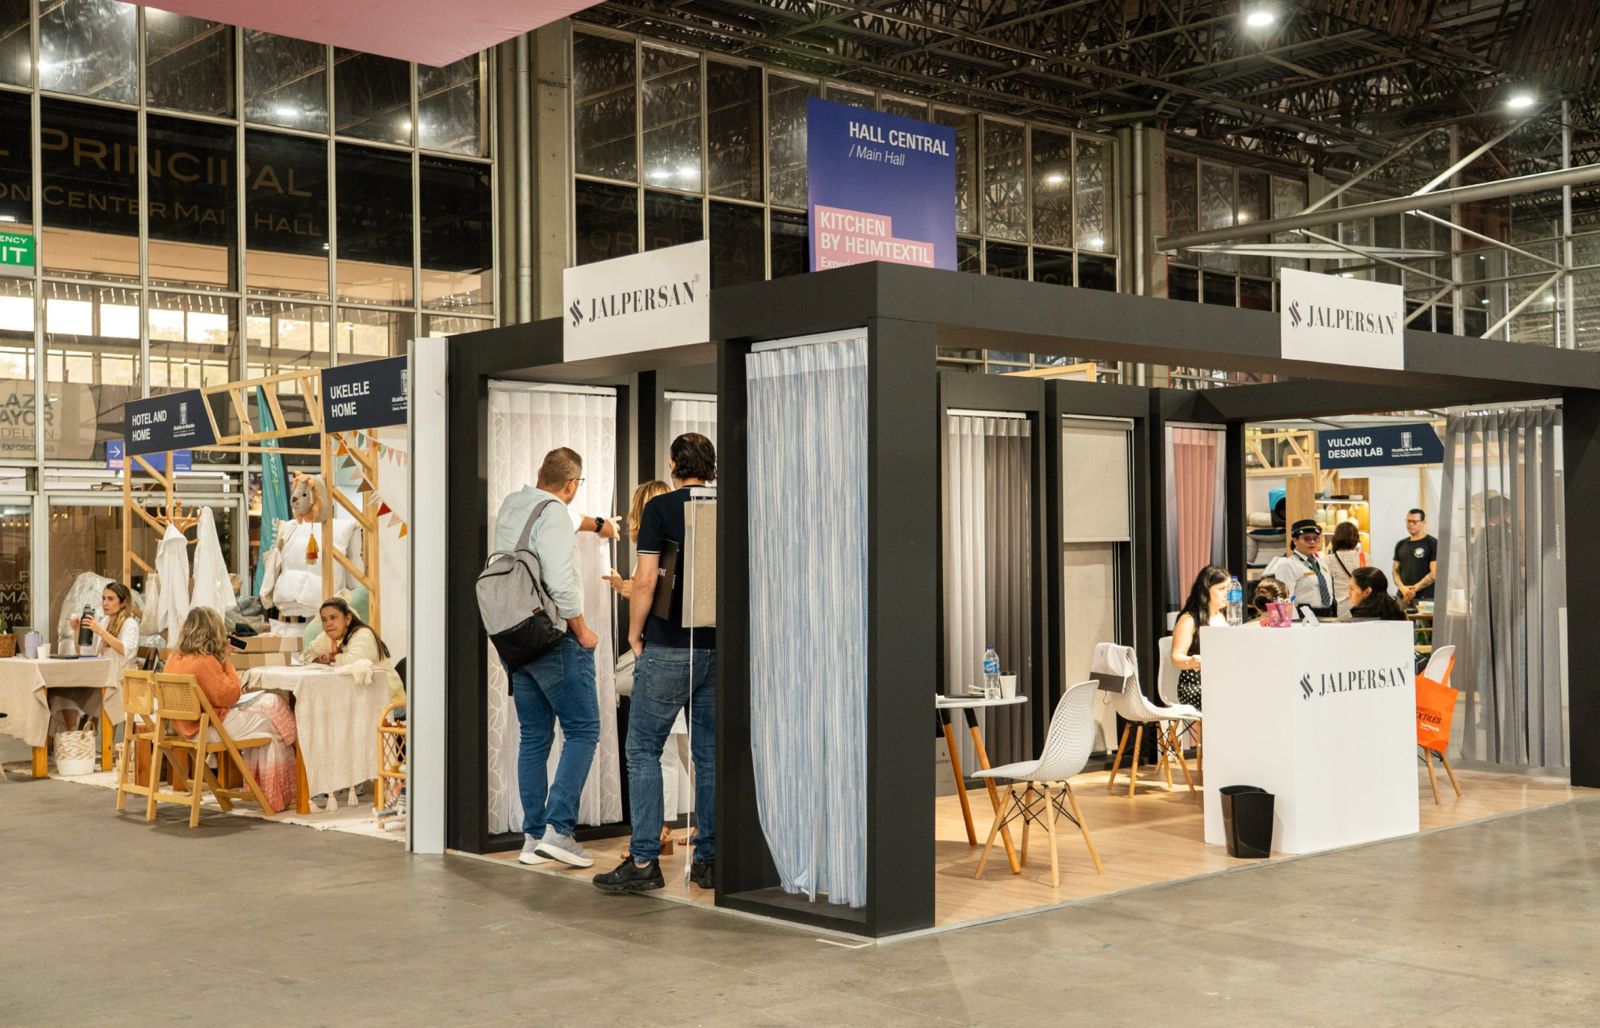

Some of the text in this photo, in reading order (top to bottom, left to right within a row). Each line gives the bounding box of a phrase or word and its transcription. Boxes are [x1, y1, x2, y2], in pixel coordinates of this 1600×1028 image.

[849, 121, 950, 157] HALL CENTRAL
[856, 144, 882, 162] Main
[885, 150, 905, 166] Hall
[42, 186, 167, 219] CENTER
[175, 202, 226, 226] MAI
[254, 212, 322, 237] HALL
[820, 211, 886, 237] KITCHEN
[821, 233, 932, 264] BY HEIMTEXTIL
[330, 381, 370, 400] UKELELE
[0, 393, 53, 410] AZA
[331, 401, 357, 418] HOME
[132, 410, 167, 427] HOTEL AND
[1, 427, 54, 439] DELLN
[132, 428, 151, 442] HOME
[1327, 436, 1372, 447] VULCANO
[1328, 448, 1362, 459] DESIGN
[1364, 447, 1383, 457] LAB
